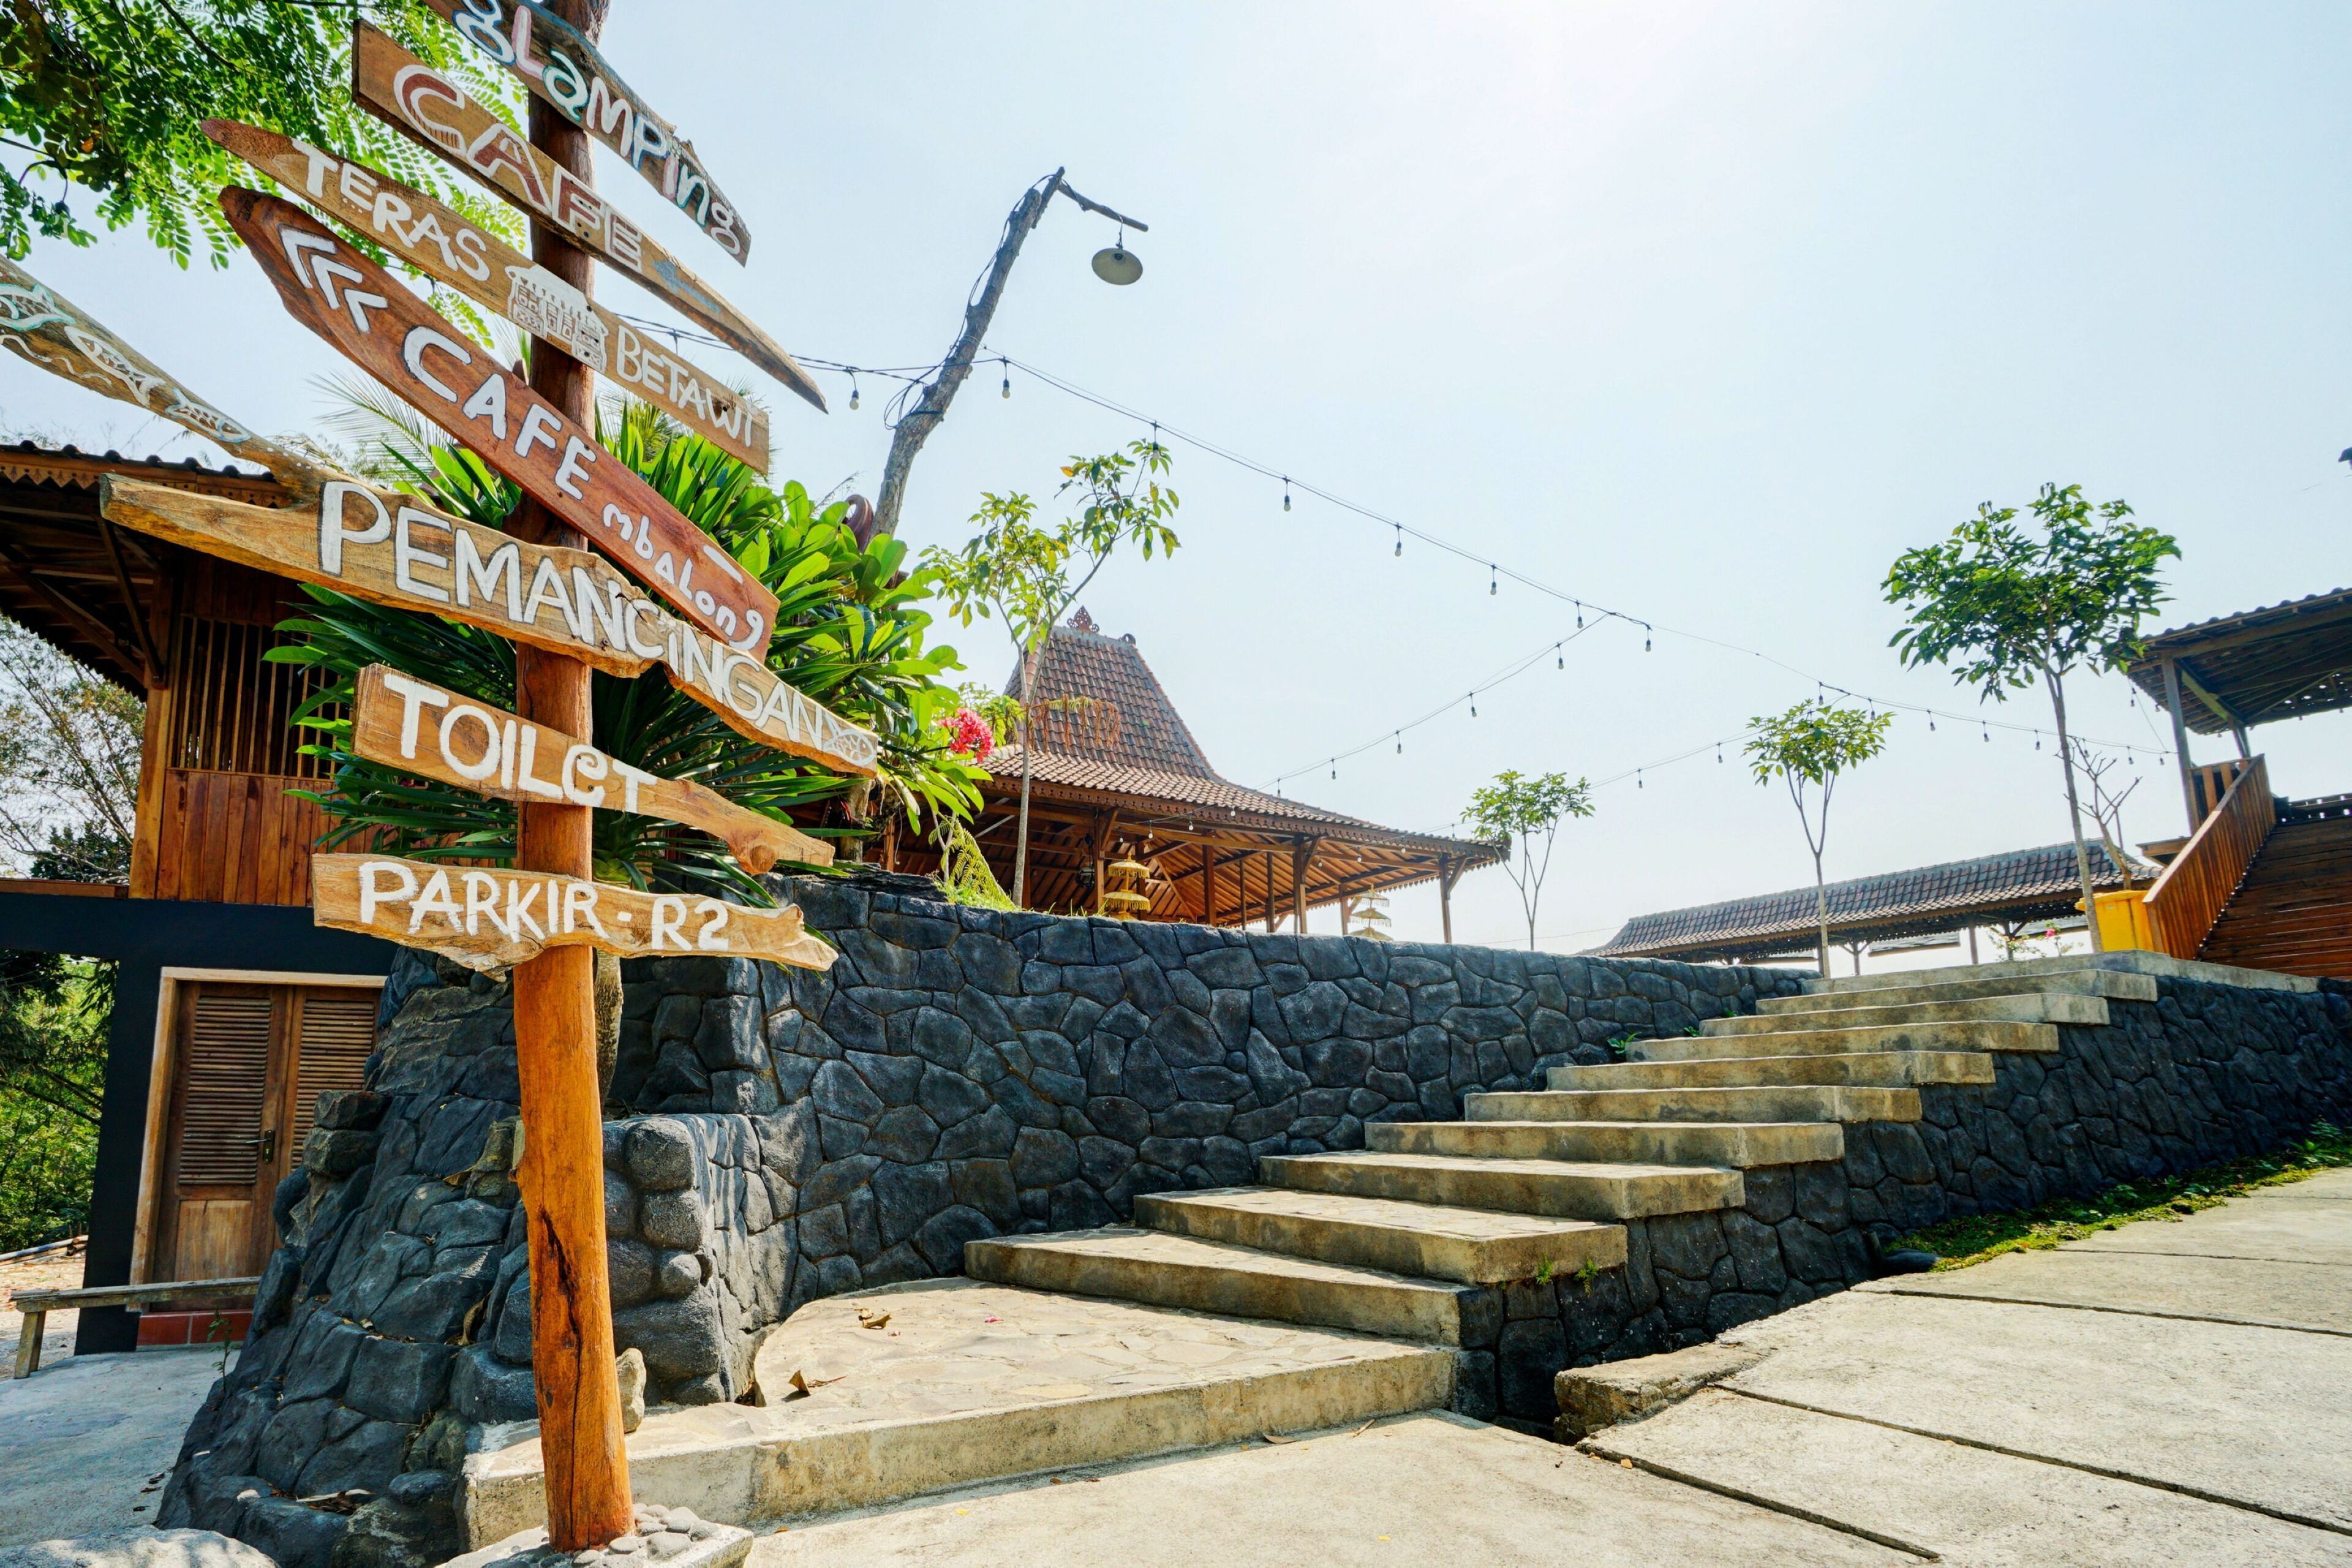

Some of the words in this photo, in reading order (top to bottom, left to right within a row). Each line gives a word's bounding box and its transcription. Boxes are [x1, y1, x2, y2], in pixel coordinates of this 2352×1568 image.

[291, 137, 490, 281] TERAS
[394, 64, 643, 274] CAFE
[402, 325, 597, 501] CAFE
[358, 861, 609, 943] PARKIR
[651, 896, 729, 952] R2
